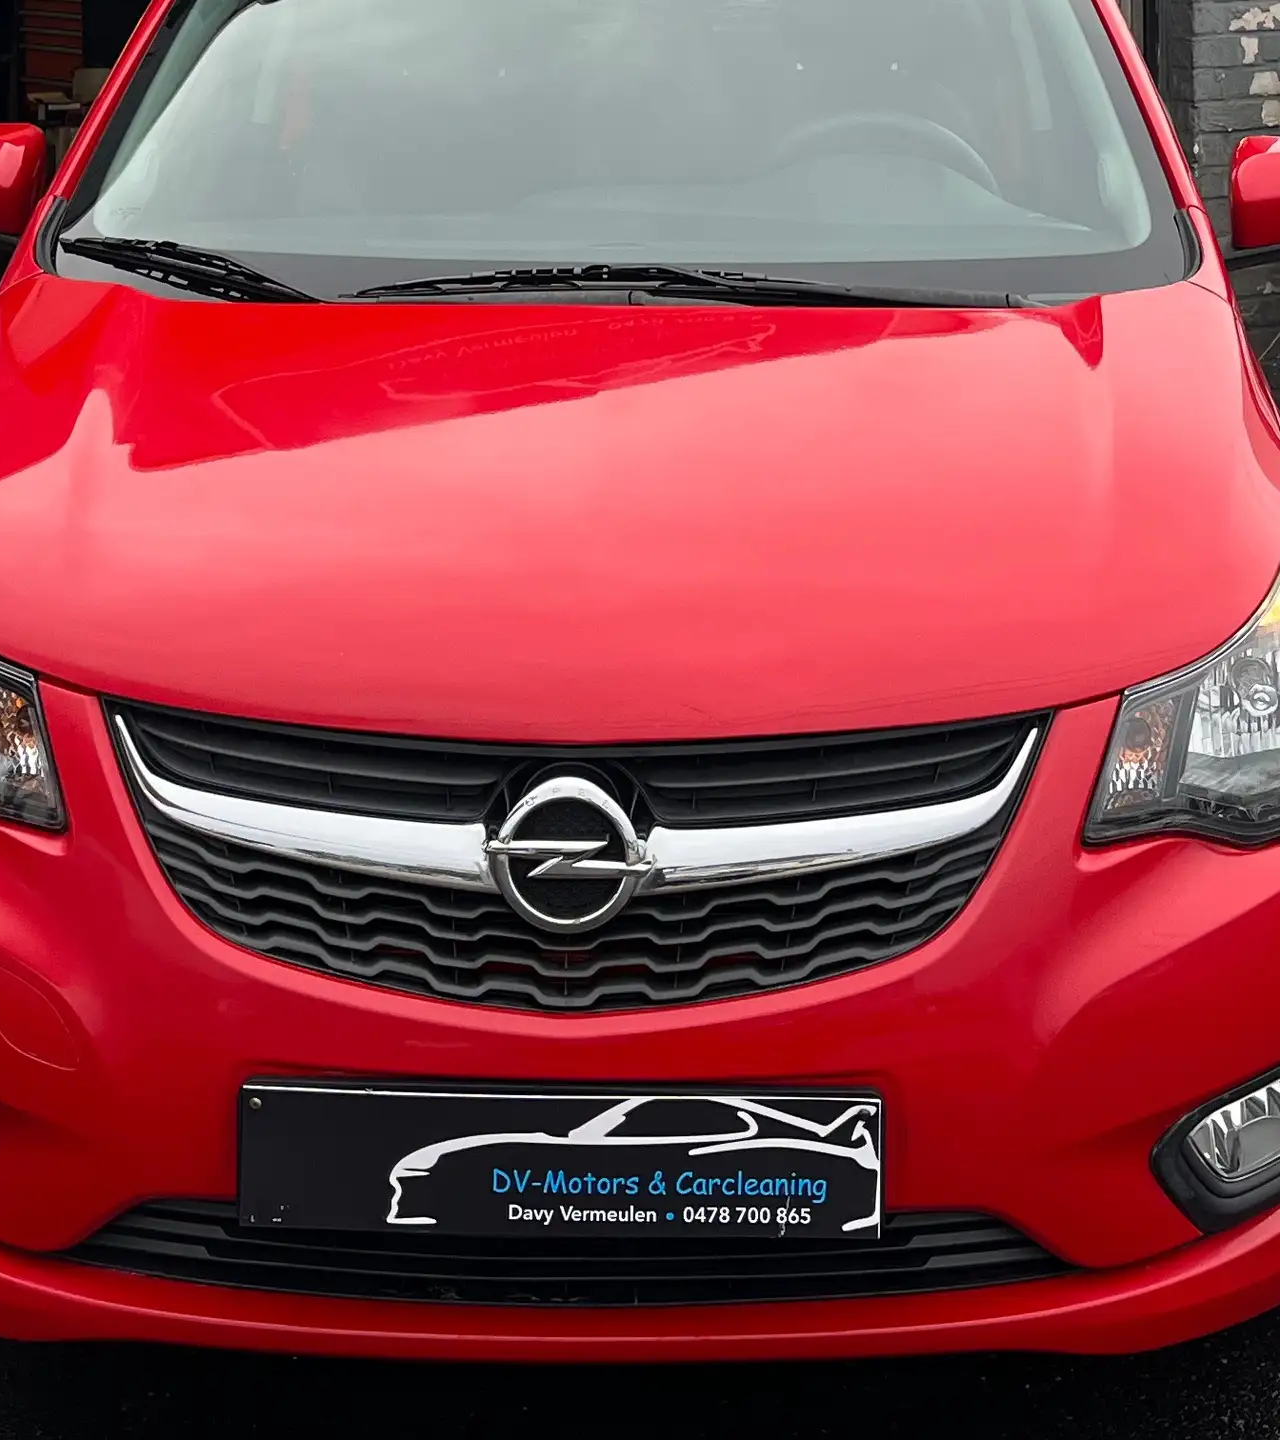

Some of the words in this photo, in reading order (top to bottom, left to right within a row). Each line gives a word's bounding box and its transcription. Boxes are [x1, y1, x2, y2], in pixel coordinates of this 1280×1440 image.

[492, 1167, 640, 1196] DV-Motors
[647, 1170, 667, 1196] &
[675, 1170, 828, 1204] Carcleaning
[507, 1203, 554, 1226] Davy
[559, 1204, 658, 1223] Vermeulen
[682, 1206, 731, 1224] 0478
[735, 1206, 771, 1224] 700
[775, 1207, 812, 1225] 865
